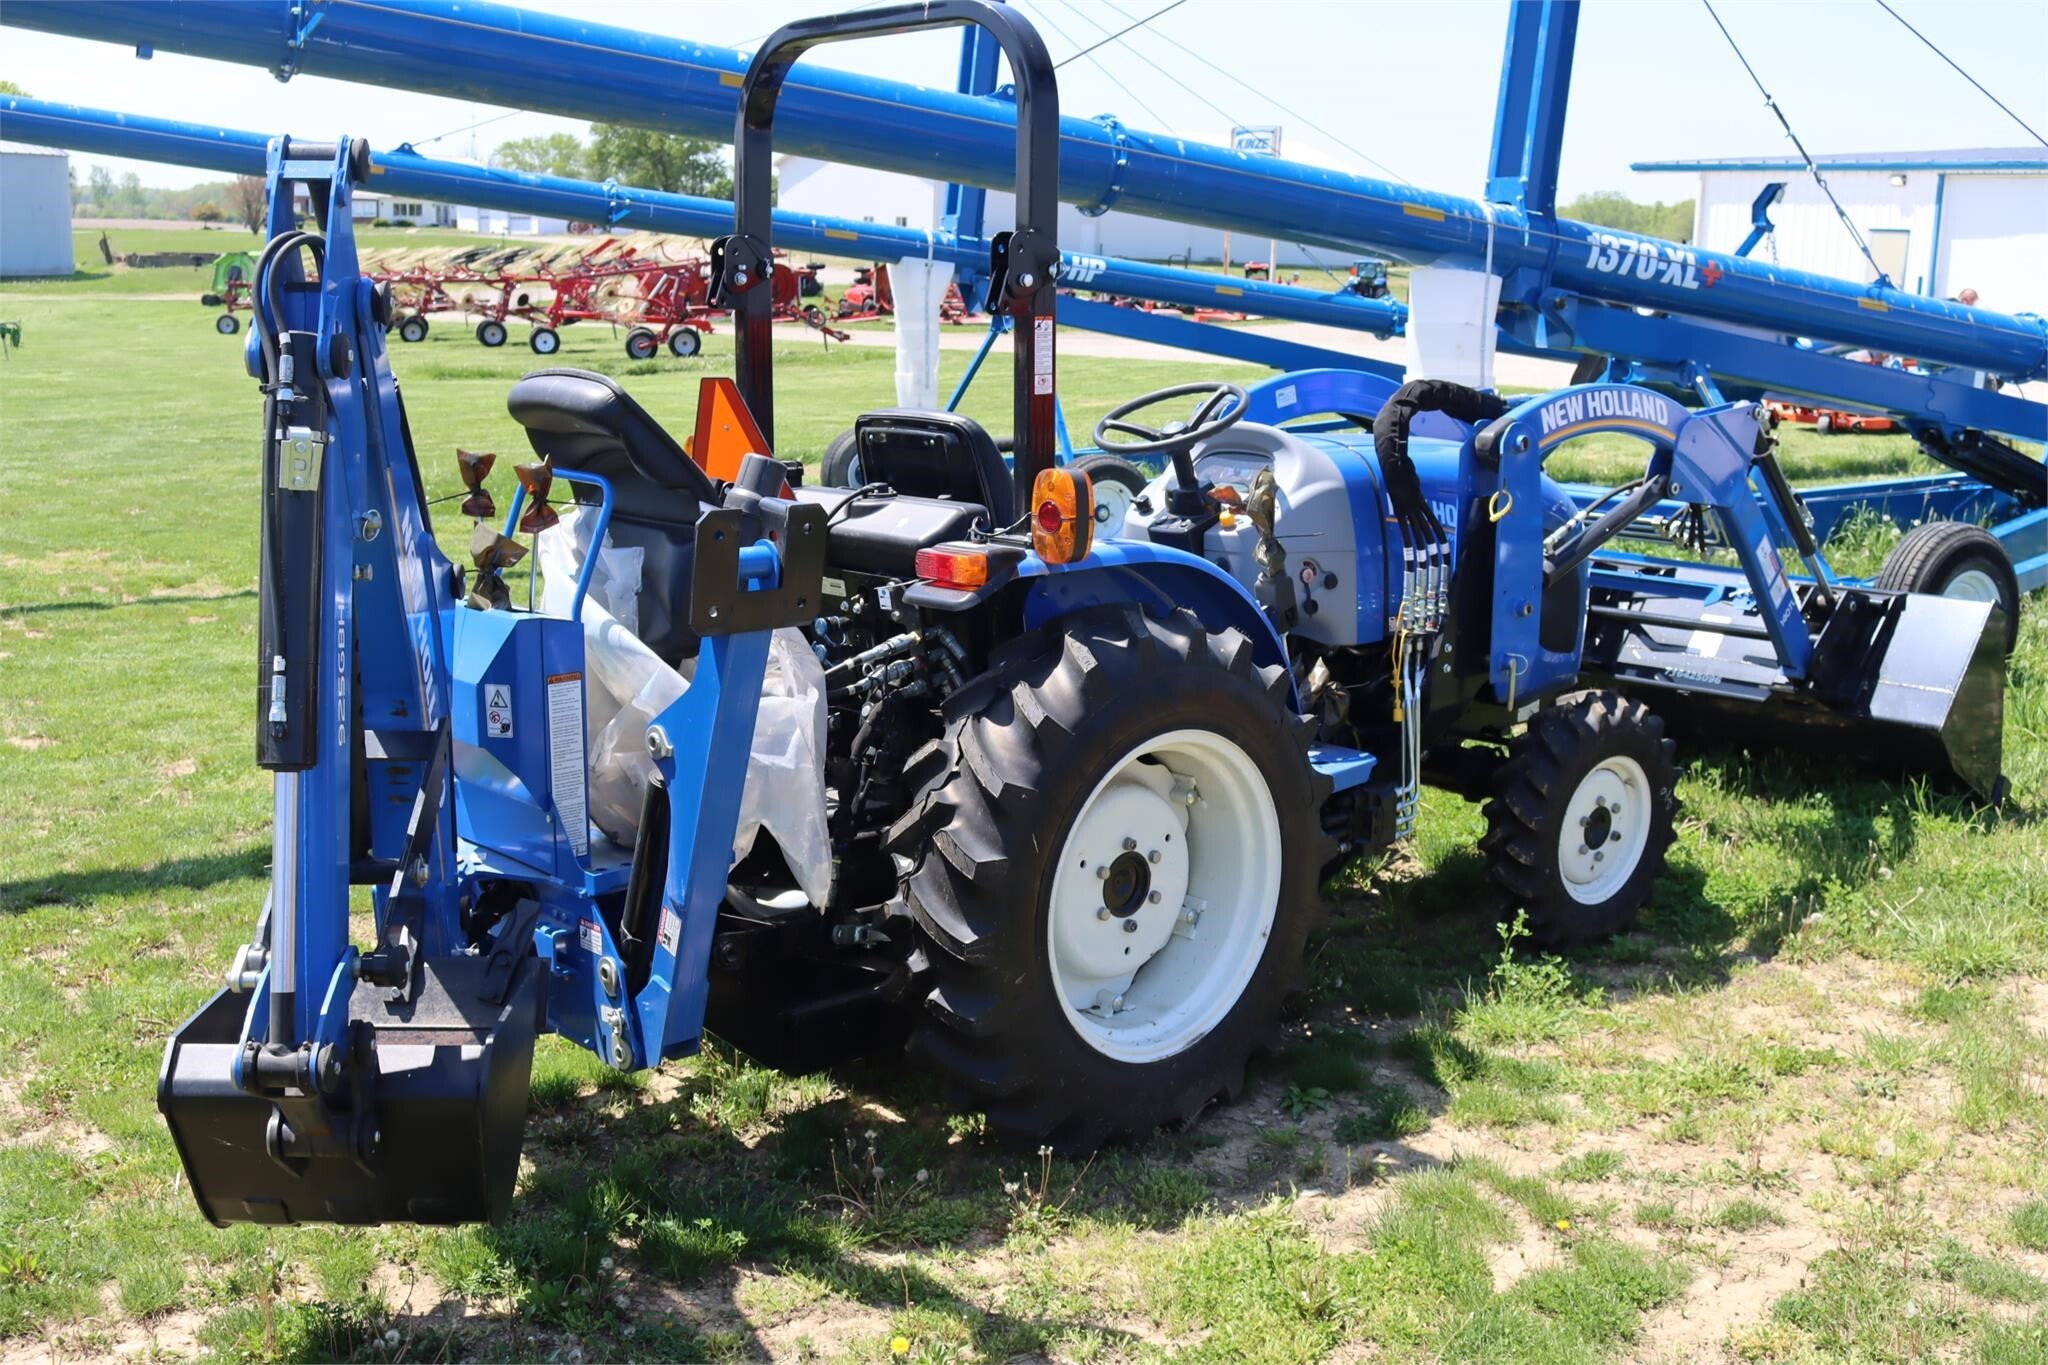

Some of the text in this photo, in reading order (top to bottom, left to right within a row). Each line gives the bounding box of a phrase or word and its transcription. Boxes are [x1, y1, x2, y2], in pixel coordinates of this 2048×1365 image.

[1541, 390, 1669, 434] NEW HOLLAND
[337, 604, 346, 748] 925GBH
